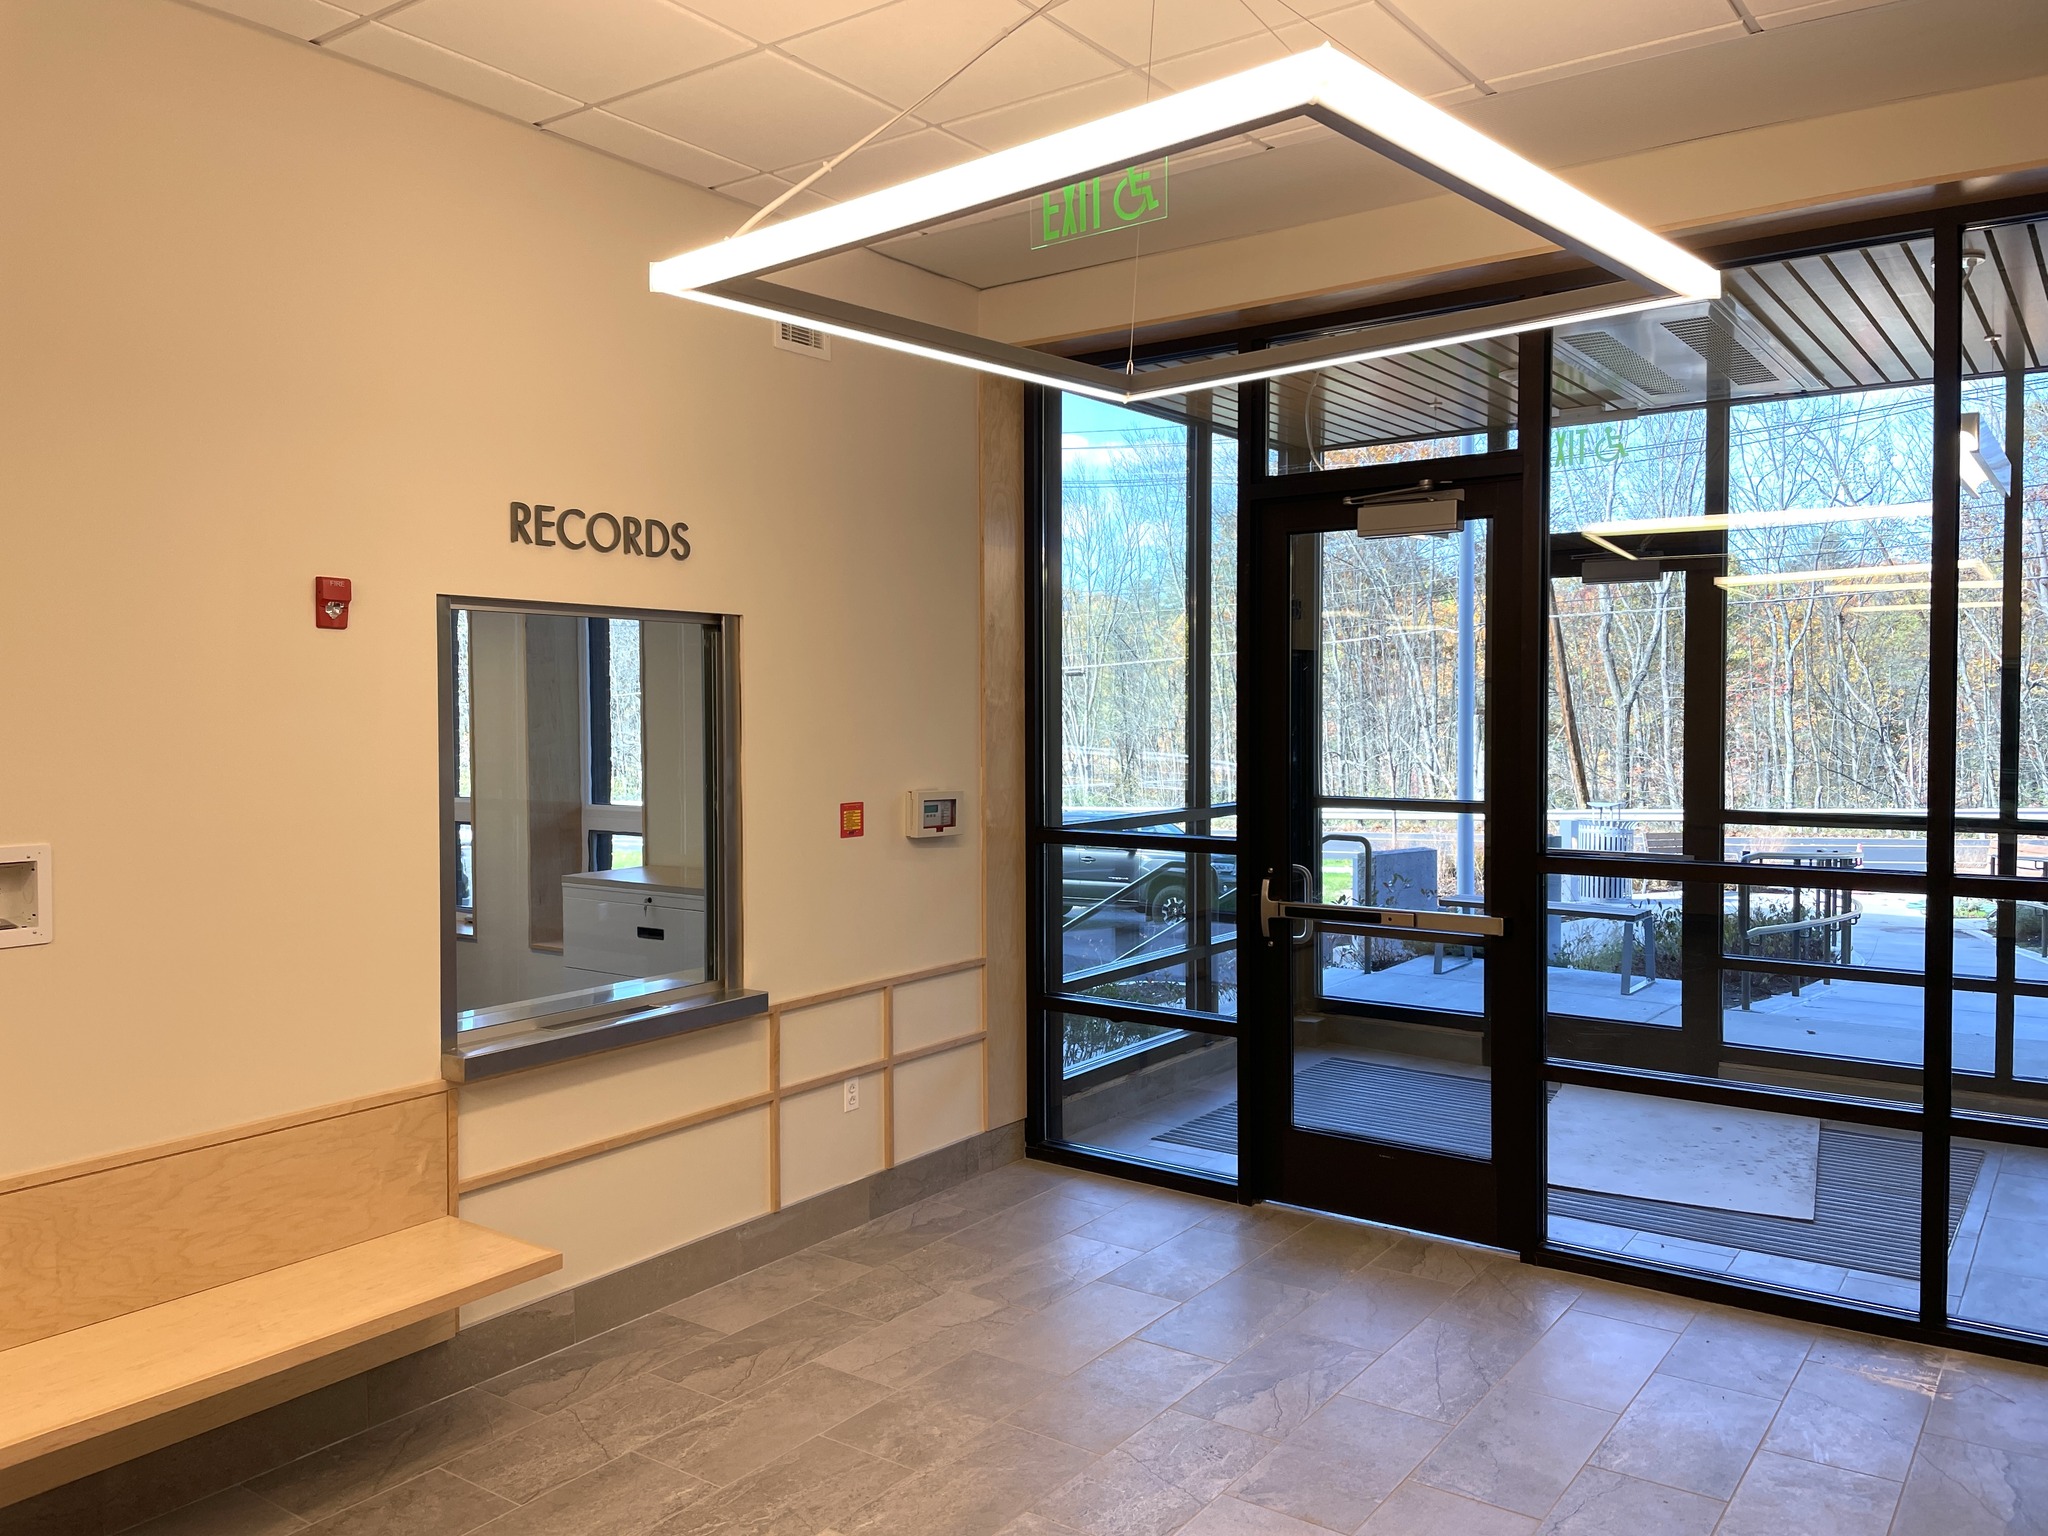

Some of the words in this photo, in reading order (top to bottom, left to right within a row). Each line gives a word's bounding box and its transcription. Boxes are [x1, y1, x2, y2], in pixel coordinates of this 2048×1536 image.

[1555, 428, 1588, 467] XIT
[510, 501, 691, 561] RECORDS
[329, 580, 346, 588] FIRE
